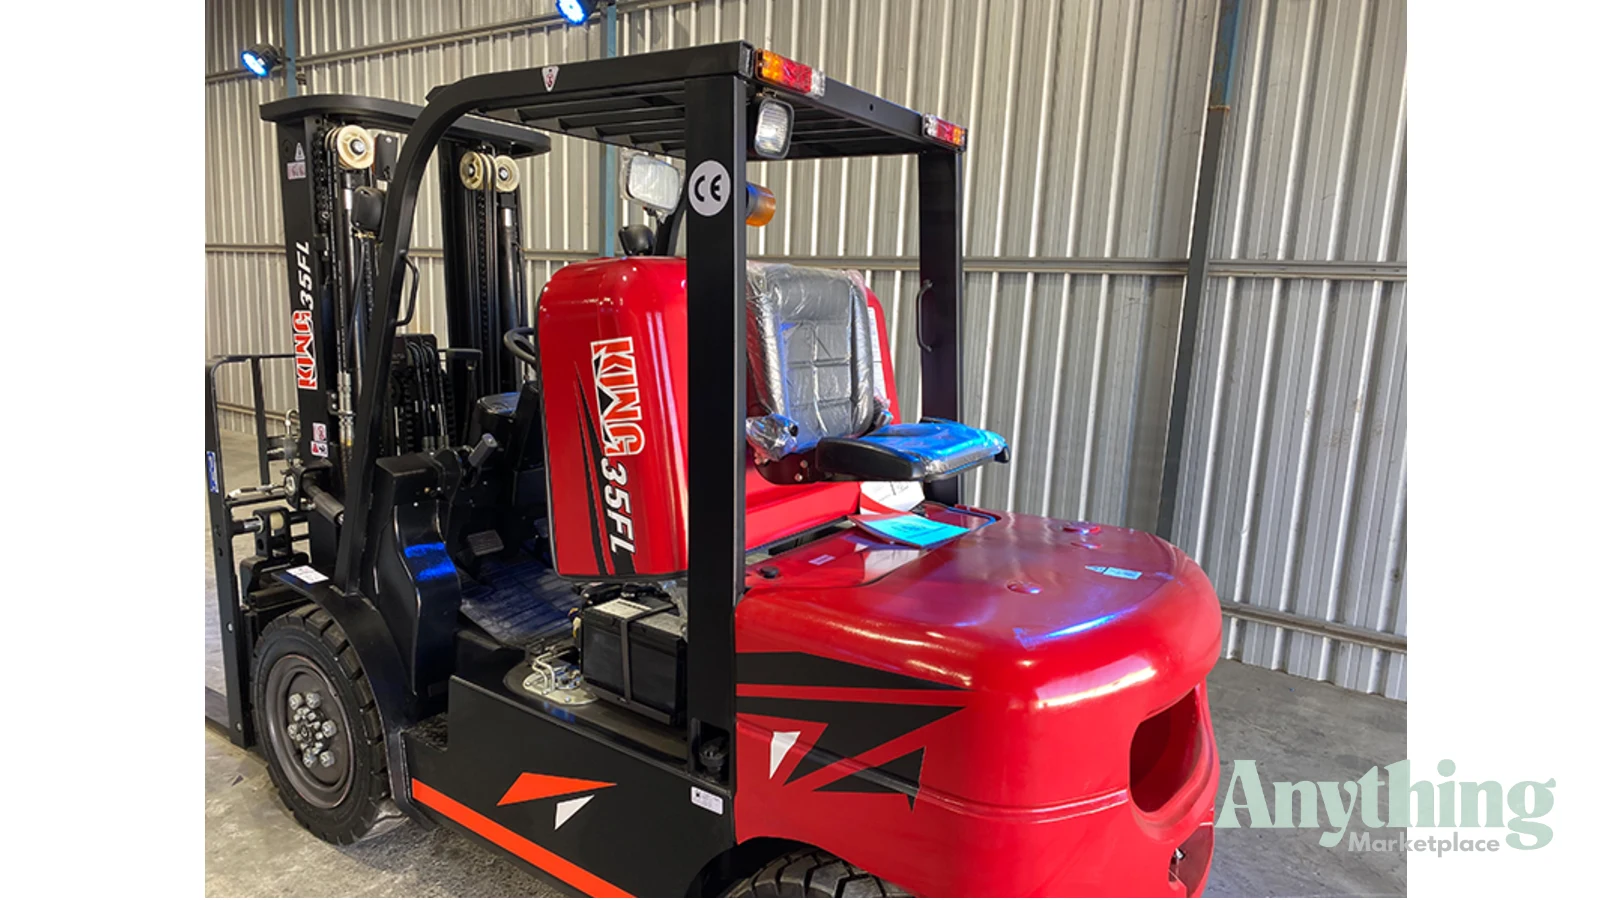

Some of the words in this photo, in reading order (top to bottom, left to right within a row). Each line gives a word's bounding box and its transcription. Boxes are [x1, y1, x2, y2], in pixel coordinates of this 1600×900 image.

[694, 174, 722, 202] CE
[296, 241, 314, 310] 35FL
[292, 310, 318, 390] KING
[590, 336, 645, 457] KING
[601, 456, 635, 554] 35FL
